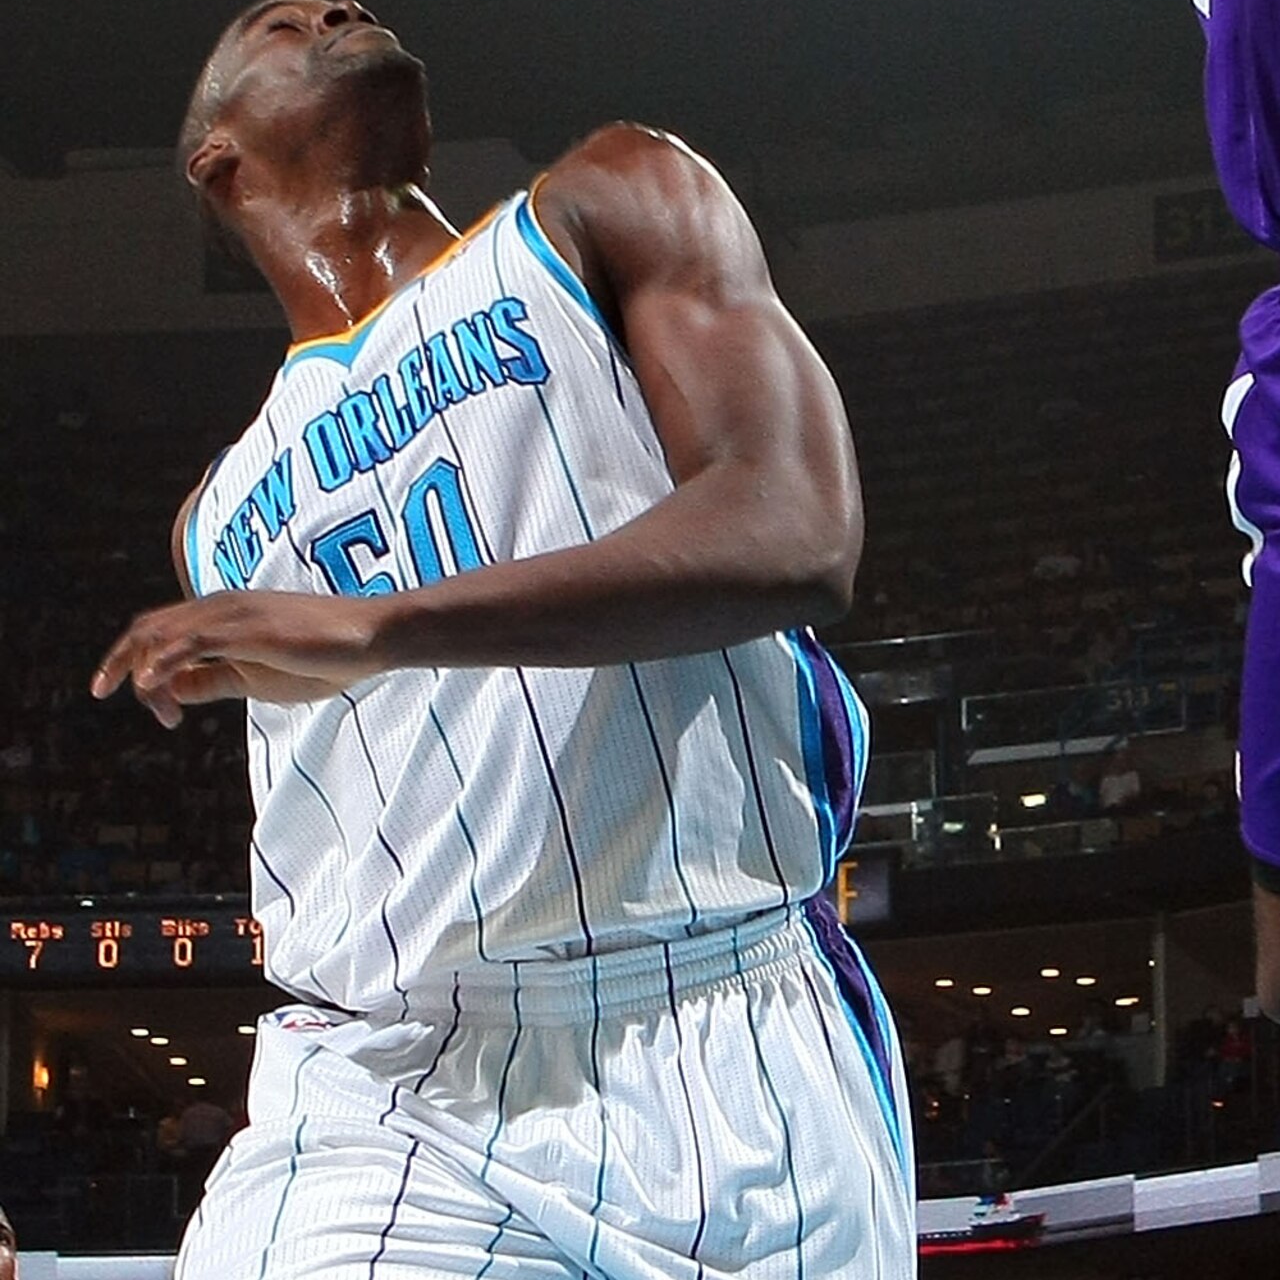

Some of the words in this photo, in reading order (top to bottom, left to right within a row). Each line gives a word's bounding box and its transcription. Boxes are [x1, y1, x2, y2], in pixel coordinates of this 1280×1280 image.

[214, 447, 296, 590] NEW
[302, 296, 551, 494] ORLEANS
[24, 939, 43, 968] 7
[98, 938, 118, 967] 0
[174, 937, 193, 966] 0
